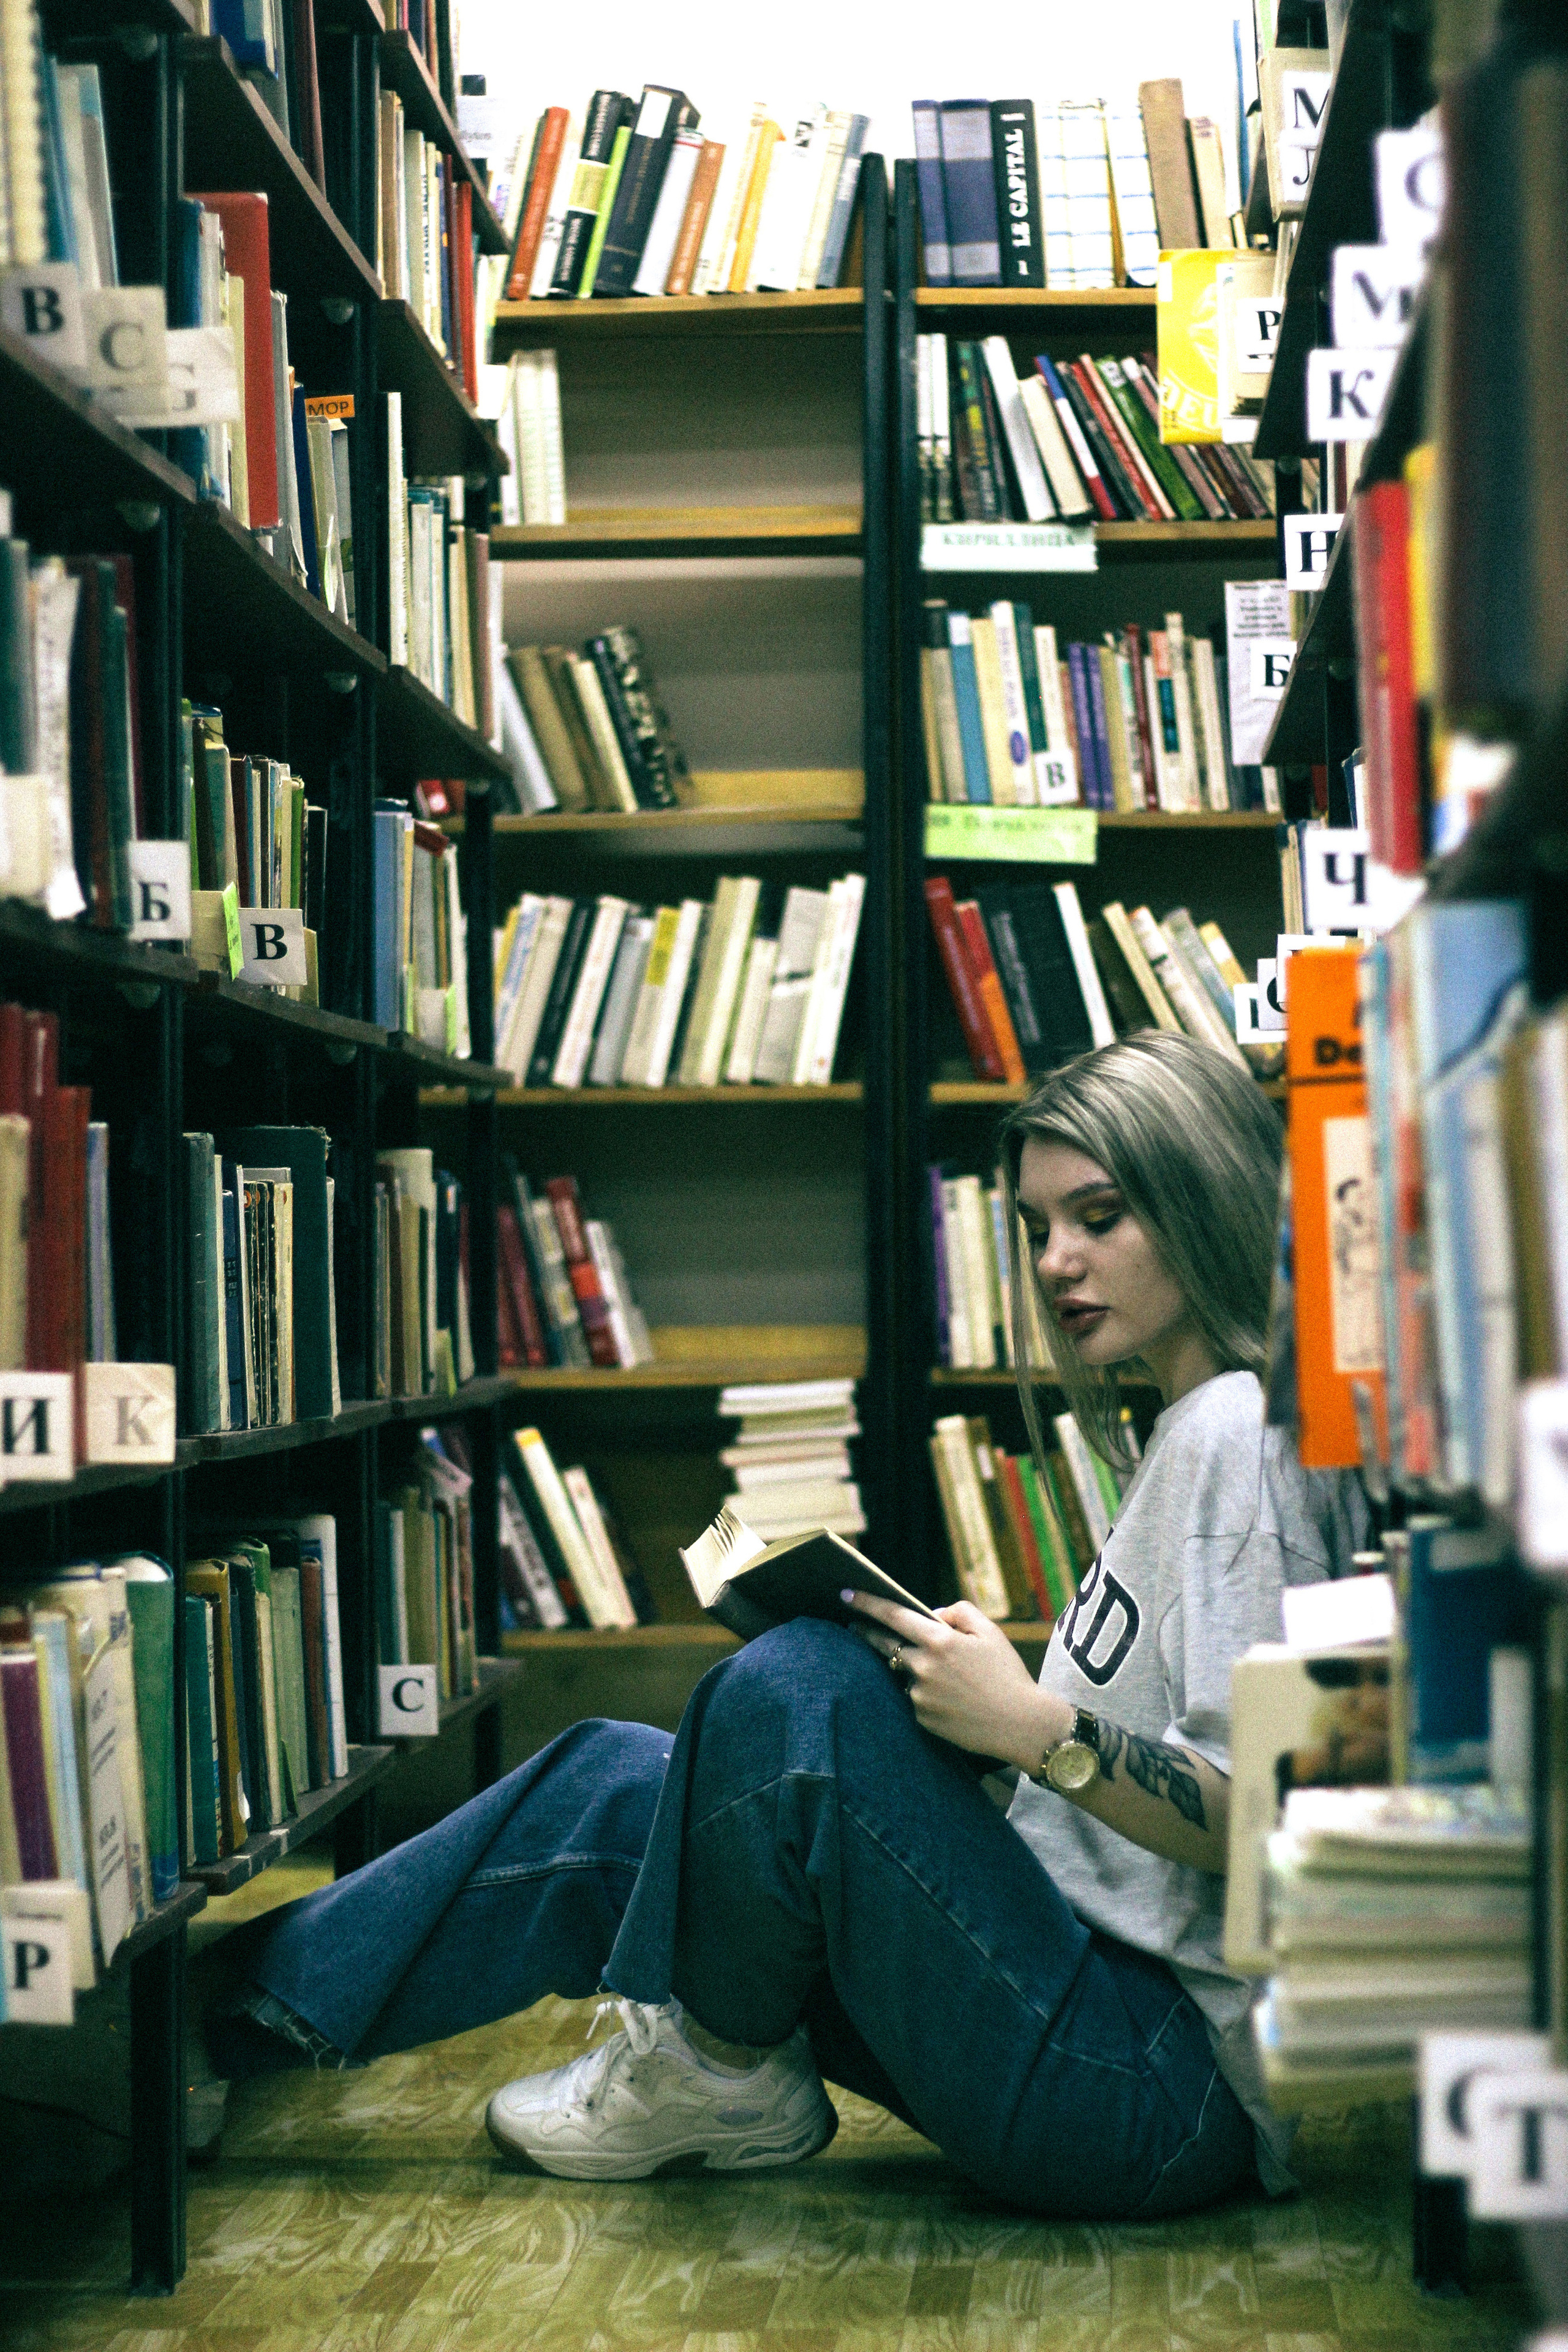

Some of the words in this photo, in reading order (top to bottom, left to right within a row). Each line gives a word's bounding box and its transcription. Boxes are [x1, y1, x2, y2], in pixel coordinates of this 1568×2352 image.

[1004, 127, 1030, 219] CAPITAL
[1011, 221, 1032, 247] LE
[1262, 654, 1290, 687] Б
[140, 880, 170, 922] Б
[251, 922, 288, 960] В
[2, 1398, 50, 1455] И
[112, 1394, 158, 1447] К
